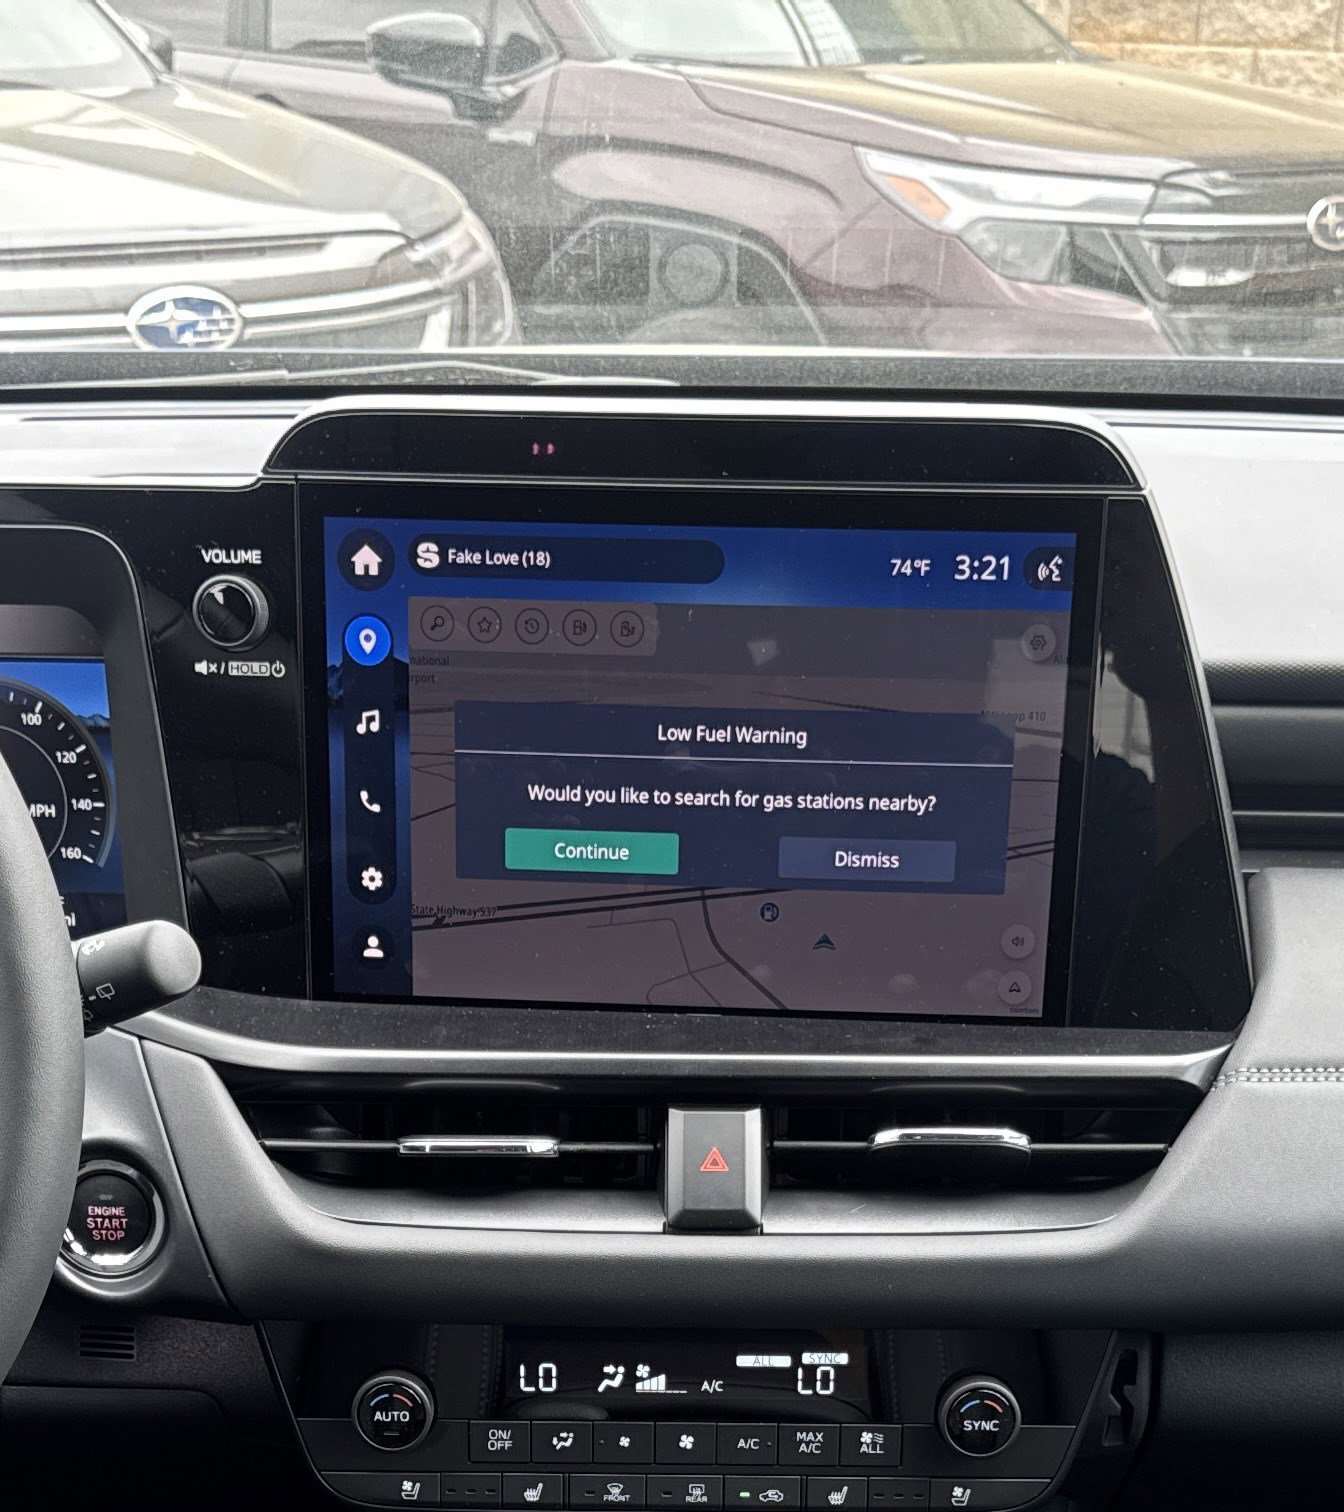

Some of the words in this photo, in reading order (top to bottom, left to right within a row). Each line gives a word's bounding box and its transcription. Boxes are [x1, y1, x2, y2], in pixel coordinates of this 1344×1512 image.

[200, 548, 262, 564] VOLUME
[448, 548, 481, 564] Fake
[485, 549, 519, 565] Love
[522, 550, 551, 568] (18)
[890, 559, 931, 577] 74°F
[954, 554, 1010, 581] 3:21
[230, 663, 268, 675] HOLD
[21, 713, 42, 725] 100
[1028, 711, 1046, 721] 410
[657, 724, 692, 741] Low
[696, 725, 731, 742] Fuel
[735, 726, 807, 749] Warning
[56, 752, 77, 763] 120
[71, 799, 92, 810] 140
[528, 784, 581, 801] Would
[585, 789, 616, 807] you
[620, 786, 649, 804] like
[653, 790, 671, 805] to
[674, 790, 730, 807] search
[735, 790, 759, 807] for
[763, 794, 793, 812] gas
[797, 793, 864, 810] stations
[868, 794, 937, 816] nearby?
[60, 848, 82, 859] 160
[554, 842, 629, 860] Continue
[835, 851, 899, 868] Dismiss
[88, 1205, 125, 1216] ENGINE
[86, 1217, 128, 1229] START
[92, 1230, 125, 1241] STOP
[807, 1353, 842, 1365] SYNC
[519, 1363, 557, 1392] LO
[798, 1366, 835, 1395] LO
[701, 1379, 724, 1393] A/C
[374, 1410, 410, 1423] AUTO
[963, 1419, 1000, 1432] SYNC
[488, 1429, 511, 1441] ON/
[796, 1432, 824, 1443] MAX
[487, 1439, 513, 1451] OFF
[737, 1438, 760, 1450] A/C
[799, 1442, 822, 1454] A/C
[860, 1443, 884, 1455] ALL
[603, 1493, 631, 1502] FRONT
[685, 1494, 708, 1503] REAR
